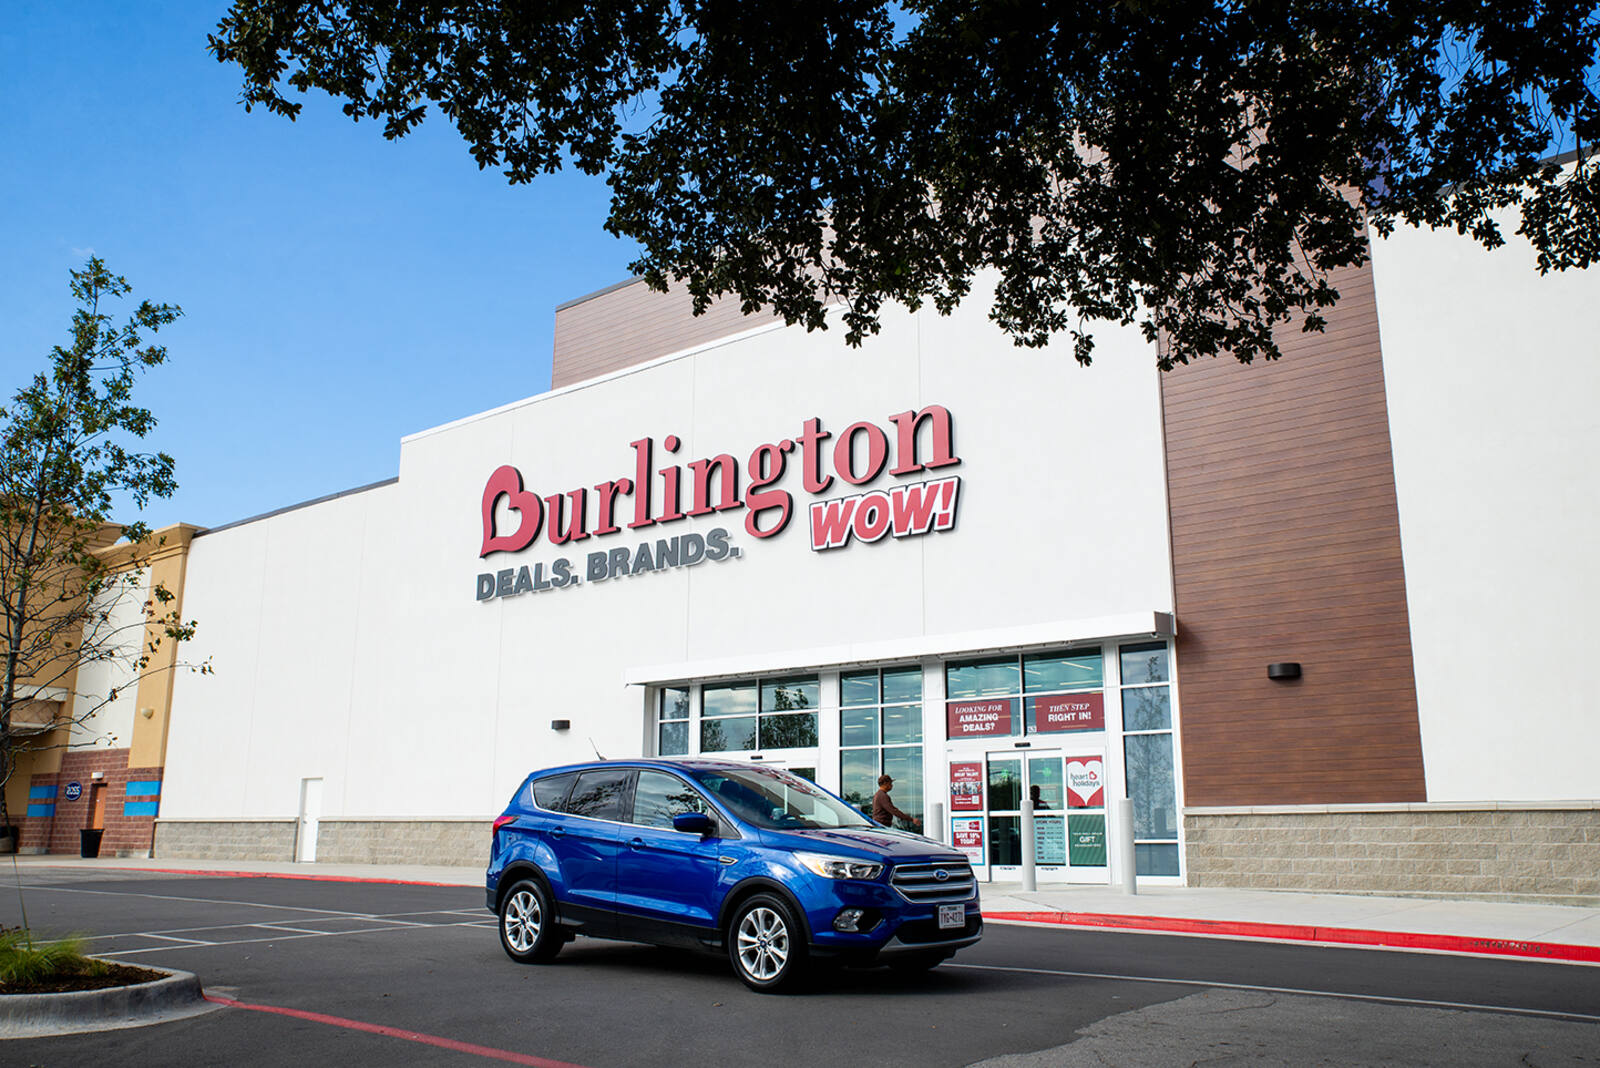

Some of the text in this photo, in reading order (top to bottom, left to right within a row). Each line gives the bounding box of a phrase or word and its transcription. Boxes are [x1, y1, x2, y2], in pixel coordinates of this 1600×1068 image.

[479, 404, 961, 558] Burlington
[476, 477, 960, 601] DEALS. BRANDS. WOW!
[955, 706, 987, 714] LOOKING
[1049, 703, 1090, 712] THEN STEP
[959, 713, 999, 722] AMAZING
[1048, 712, 1092, 722] RIGHT IN!
[963, 723, 995, 732] DEALS?
